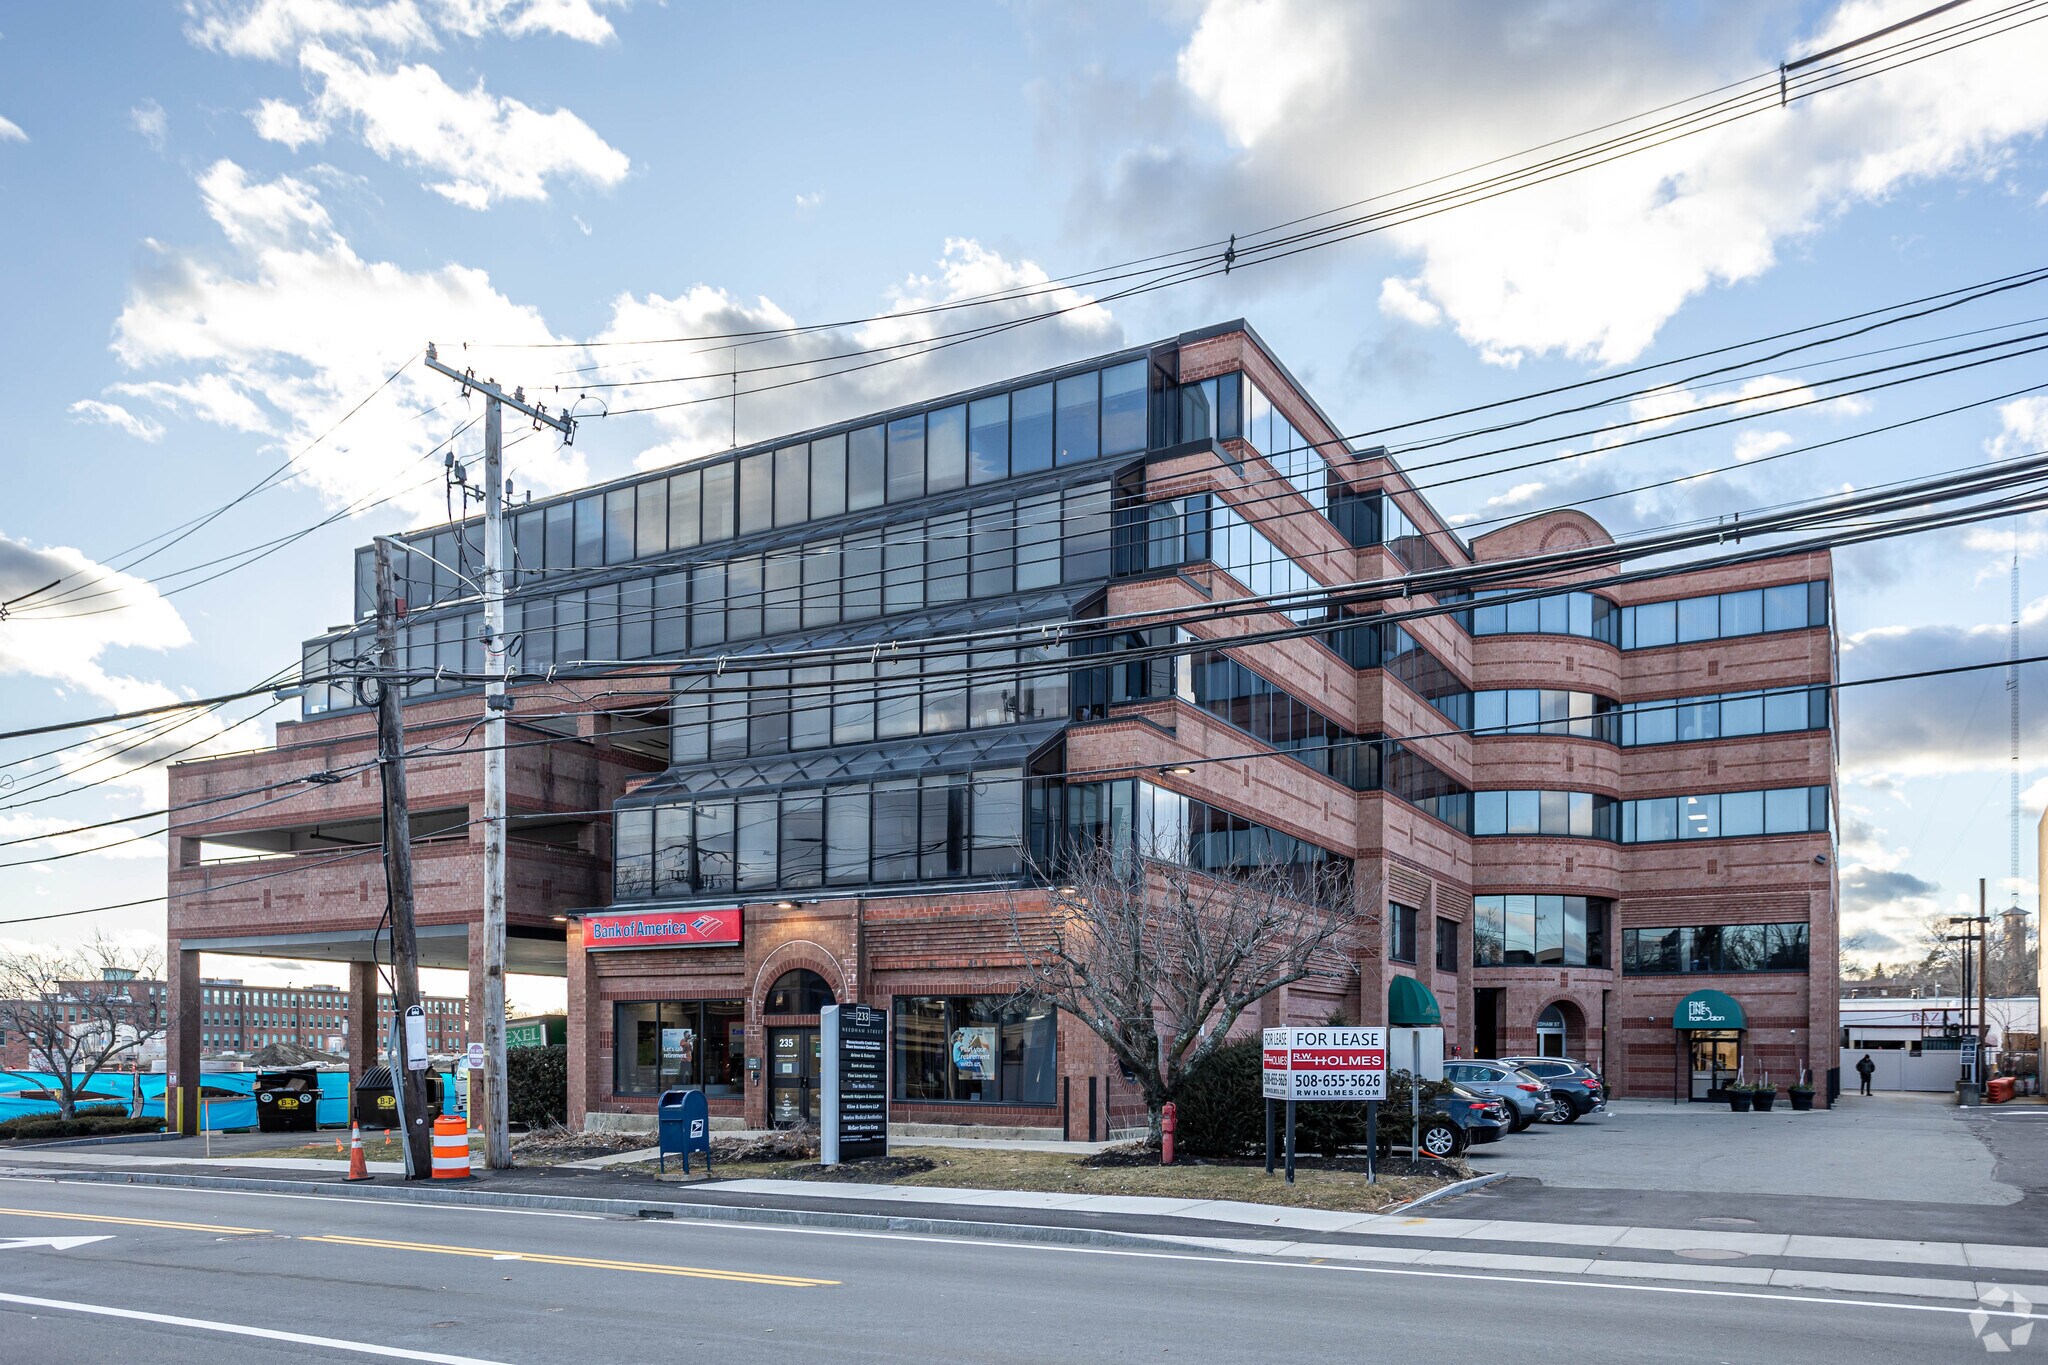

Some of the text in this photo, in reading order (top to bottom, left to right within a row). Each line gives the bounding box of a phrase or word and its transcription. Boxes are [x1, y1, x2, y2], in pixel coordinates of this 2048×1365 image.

[594, 920, 687, 938] Bank of America
[857, 1012, 869, 1021] 233
[1689, 1007, 1711, 1015] LINES
[779, 1038, 794, 1047] 235
[1264, 1032, 1287, 1045] FOR LEASE
[1297, 1032, 1379, 1046] FOR LEASE
[1269, 1055, 1287, 1066] HOLMES
[1315, 1056, 1381, 1066] HOLMES
[1295, 1074, 1380, 1087] 508-655-5626
